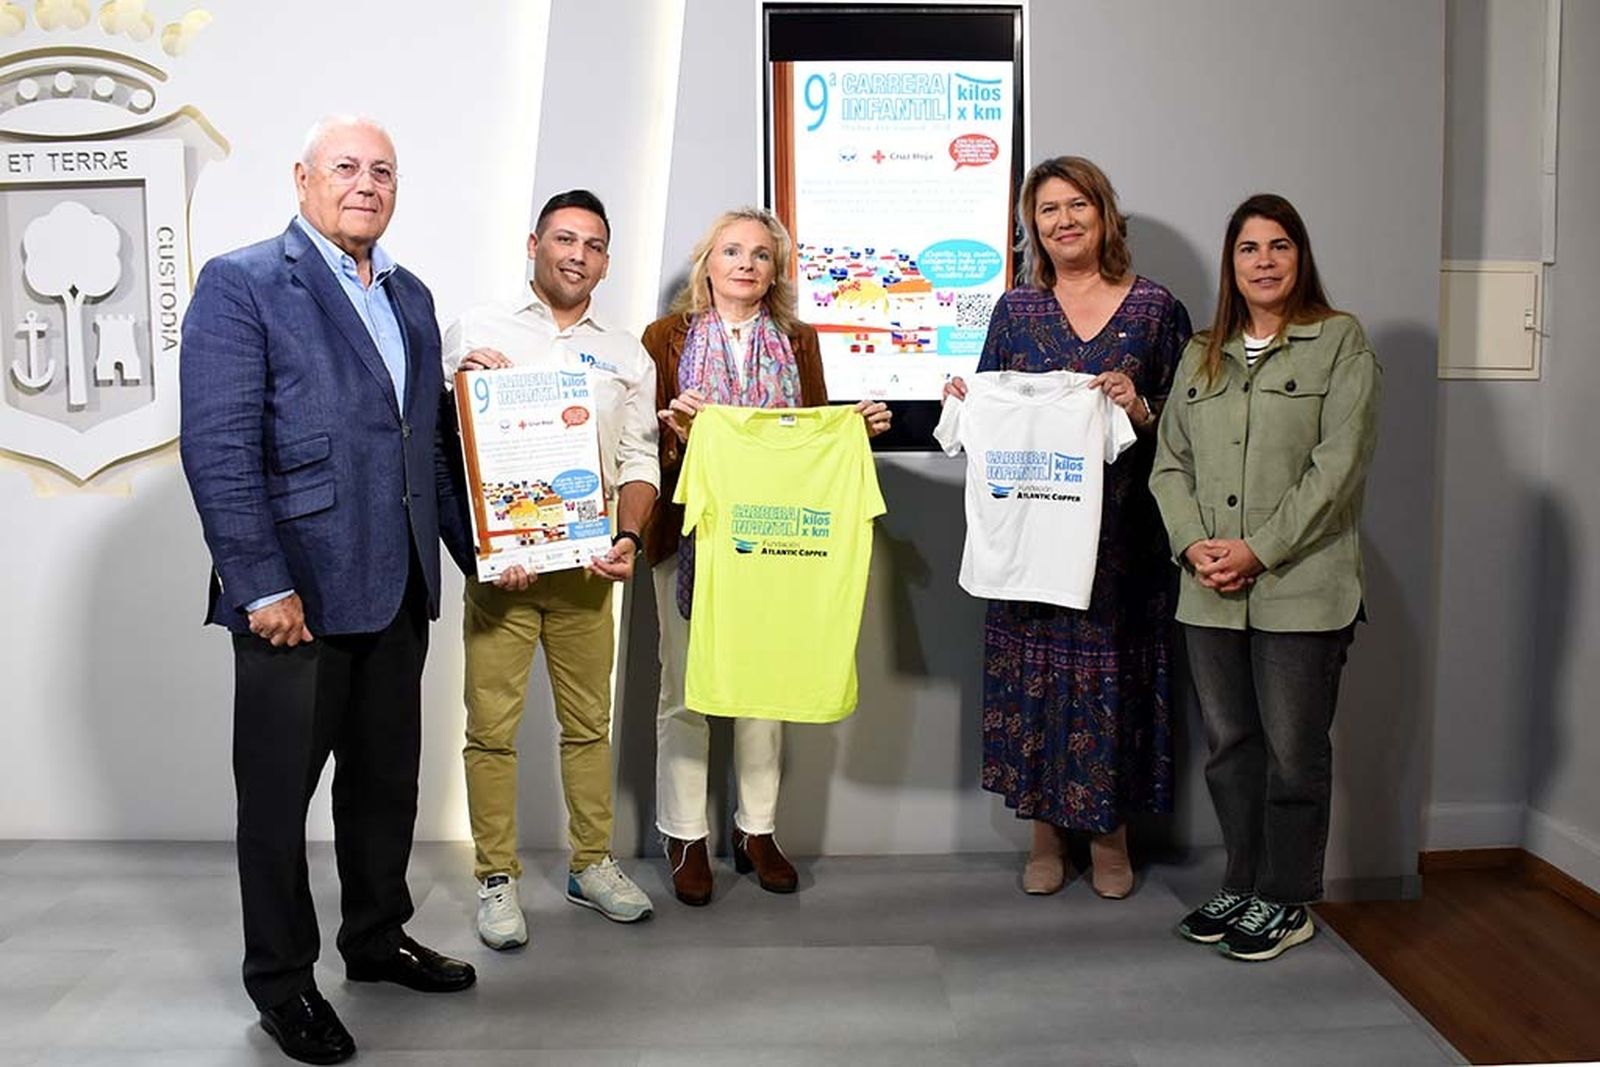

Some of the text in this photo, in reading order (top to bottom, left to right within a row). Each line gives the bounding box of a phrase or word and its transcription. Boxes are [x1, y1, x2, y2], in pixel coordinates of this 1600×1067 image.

[841, 72, 946, 95] CARRERA
[957, 84, 1001, 101] kilos
[841, 98, 946, 121] INFANTIL
[957, 103, 1001, 120] x km
[8, 153, 35, 173] ET
[156, 226, 178, 352] CUSTODIA
[561, 376, 587, 388] kilos
[985, 450, 1048, 466] CARRERA
[1055, 459, 1084, 472] kilos
[985, 465, 1051, 481] INFANTIL
[1054, 471, 1083, 483] x km
[1016, 491, 1081, 502] ATLANTIC COPPER
[731, 503, 797, 521] CARRERA
[803, 513, 831, 526] kilos
[731, 519, 798, 537] INFANTIL
[801, 526, 830, 538] x km
[761, 547, 828, 558] ATLANTIC COPPER
